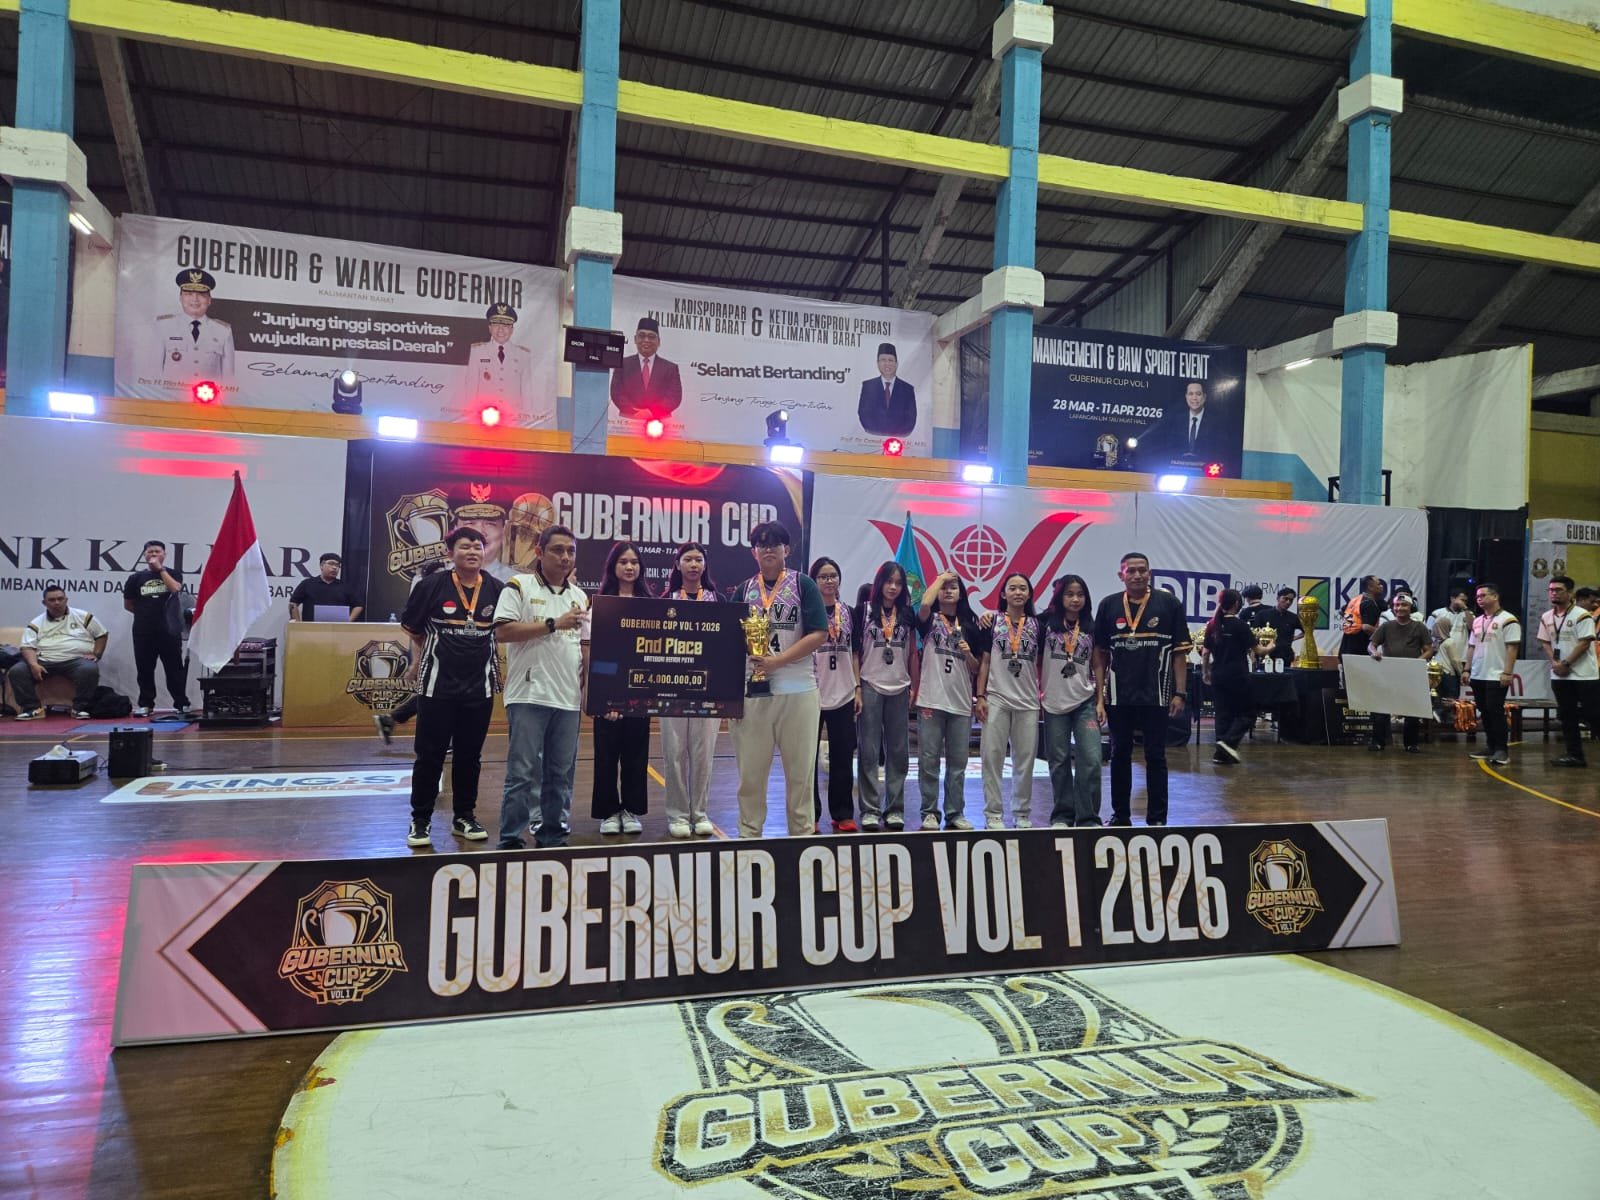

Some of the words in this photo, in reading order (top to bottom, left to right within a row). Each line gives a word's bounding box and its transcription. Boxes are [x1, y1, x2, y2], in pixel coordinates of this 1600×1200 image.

[177, 235, 298, 281] GUBERNUR
[309, 253, 323, 284] &
[336, 256, 405, 294] WAKIL
[416, 267, 522, 309] GUBERNUR
[674, 298, 747, 320] KADISPORAPAR
[328, 316, 371, 333] tinggi
[374, 321, 450, 336] sportivitas
[715, 318, 747, 336] BARAT
[752, 307, 763, 336] &
[769, 308, 799, 326] KETUA
[804, 312, 850, 332] PENGPROV
[854, 318, 891, 336] PERBASI
[250, 331, 330, 348] wujudkan
[332, 336, 390, 350] prestasi
[769, 324, 828, 344] KALIMANTAN
[832, 331, 862, 348] BARAT
[1032, 336, 1104, 370] MANAGEMENT
[1107, 345, 1115, 370] &
[1118, 345, 1142, 373] BAW
[1145, 349, 1177, 376] SPORT
[1179, 352, 1210, 380] EVENT
[247, 361, 339, 380] Selamat
[1069, 374, 1113, 385] GUBERNUR
[1114, 378, 1129, 386] CUP
[1130, 380, 1145, 388] VOL
[1052, 398, 1068, 410] 28
[1068, 400, 1094, 412] MAR
[1102, 403, 1112, 414] 11
[1112, 404, 1134, 416] APR
[1135, 406, 1163, 418] 2026
[552, 492, 710, 545] GUBERNUR
[620, 618, 661, 630] GUBERNUR
[662, 620, 678, 630] CUP
[680, 622, 693, 630] VOL
[696, 622, 700, 631] 1
[702, 622, 720, 632] 2026
[666, 638, 702, 656] Place
[770, 633, 781, 653] 4
[944, 659, 954, 674] 5
[634, 674, 646, 684] RP.
[648, 674, 702, 686] 4.000.000,00
[372, 691, 393, 701] CUP
[1248, 890, 1320, 910] GUBERNUR
[428, 849, 778, 998] GUBERNUR
[798, 843, 914, 966] CUP
[932, 838, 1042, 955] VOL
[1055, 838, 1082, 948] 1
[1094, 832, 1230, 946] 2026
[1274, 906, 1296, 922] CUP
[281, 944, 402, 974] GUBERNUR
[324, 967, 360, 988] CUP
[330, 990, 345, 999] VOL
[346, 989, 350, 998] 1
[673, 1043, 1309, 1170] GUBERNUR
[942, 1112, 1145, 1190] CUP
